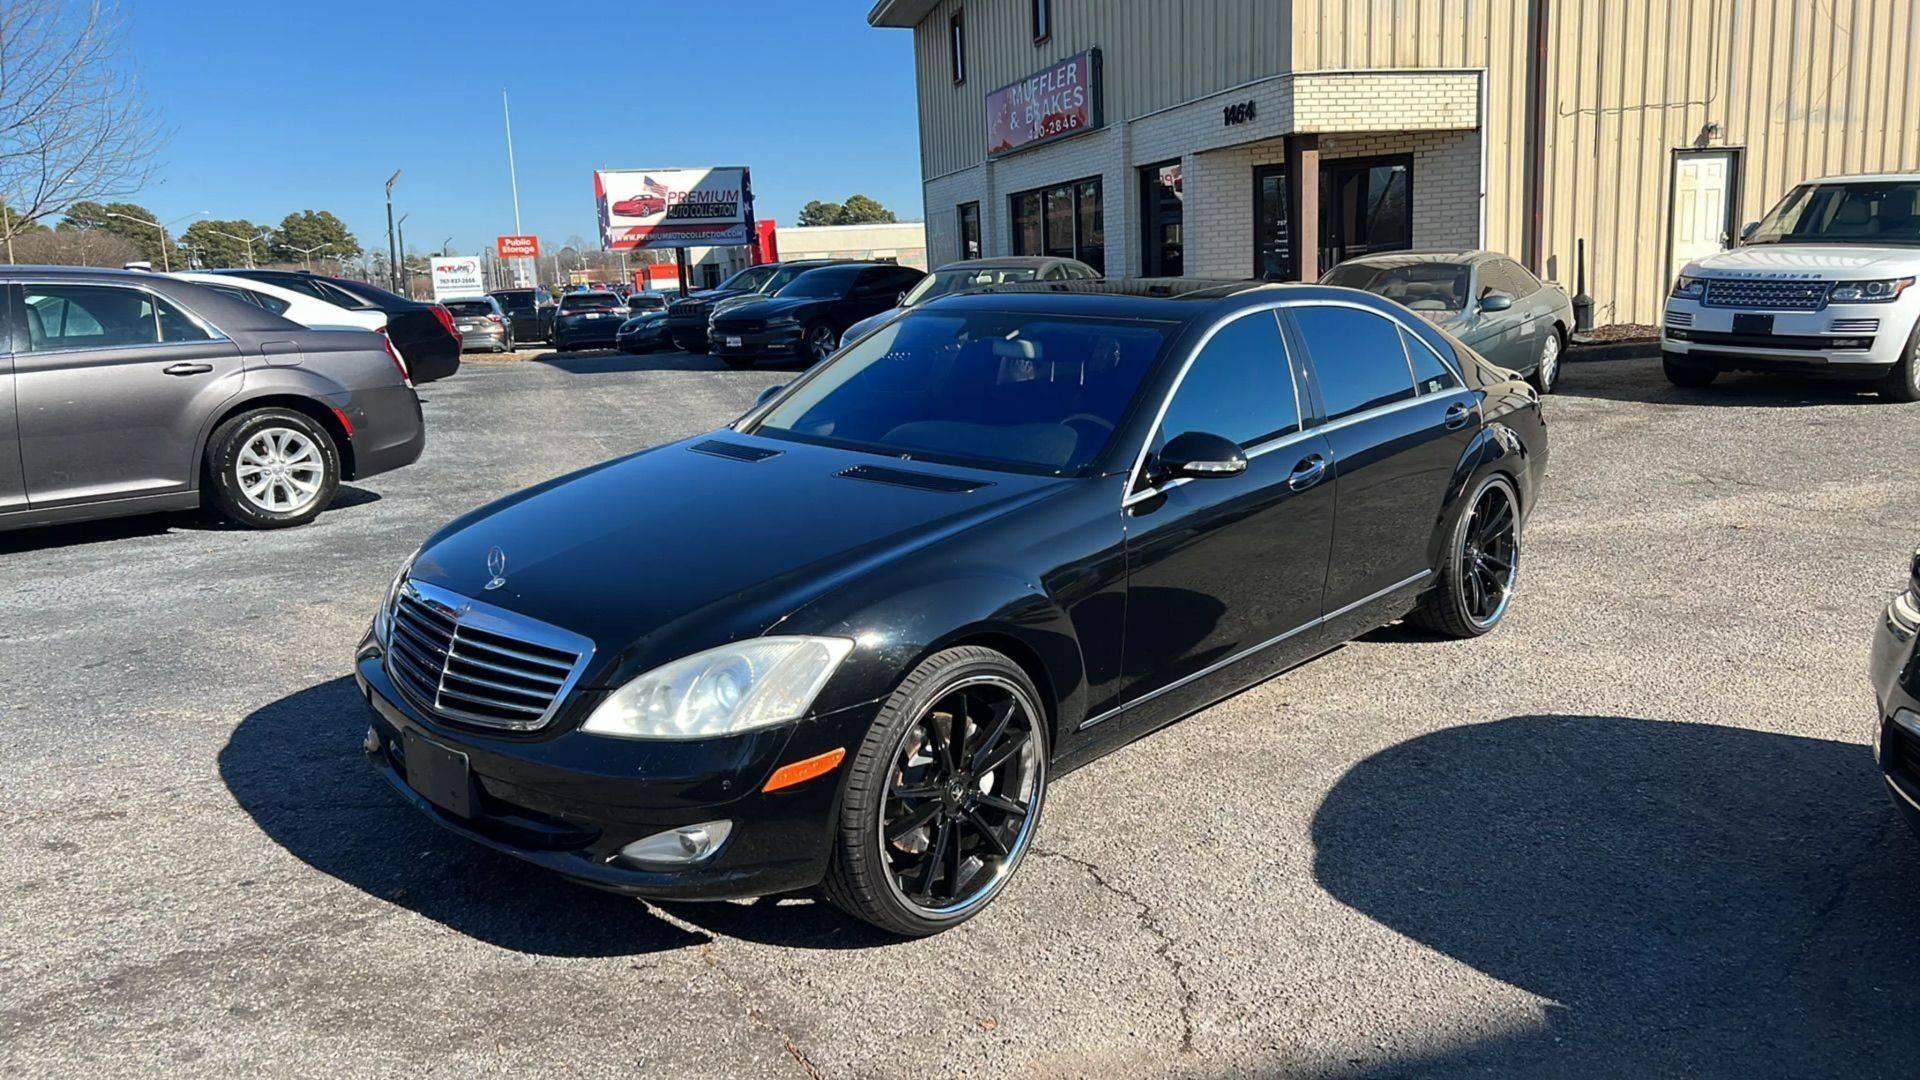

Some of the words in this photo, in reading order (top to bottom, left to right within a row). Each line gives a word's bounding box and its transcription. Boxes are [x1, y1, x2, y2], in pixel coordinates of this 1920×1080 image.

[1012, 63, 1077, 106] MUFFLER
[1010, 111, 1020, 130] &
[1025, 85, 1085, 124] BRAKES
[1222, 100, 1257, 126] 1464
[668, 189, 740, 204] PREMIUM
[668, 205, 689, 218] AUTO
[690, 204, 737, 218] COLLECTION
[504, 238, 532, 247] Public
[501, 246, 536, 255] Storage
